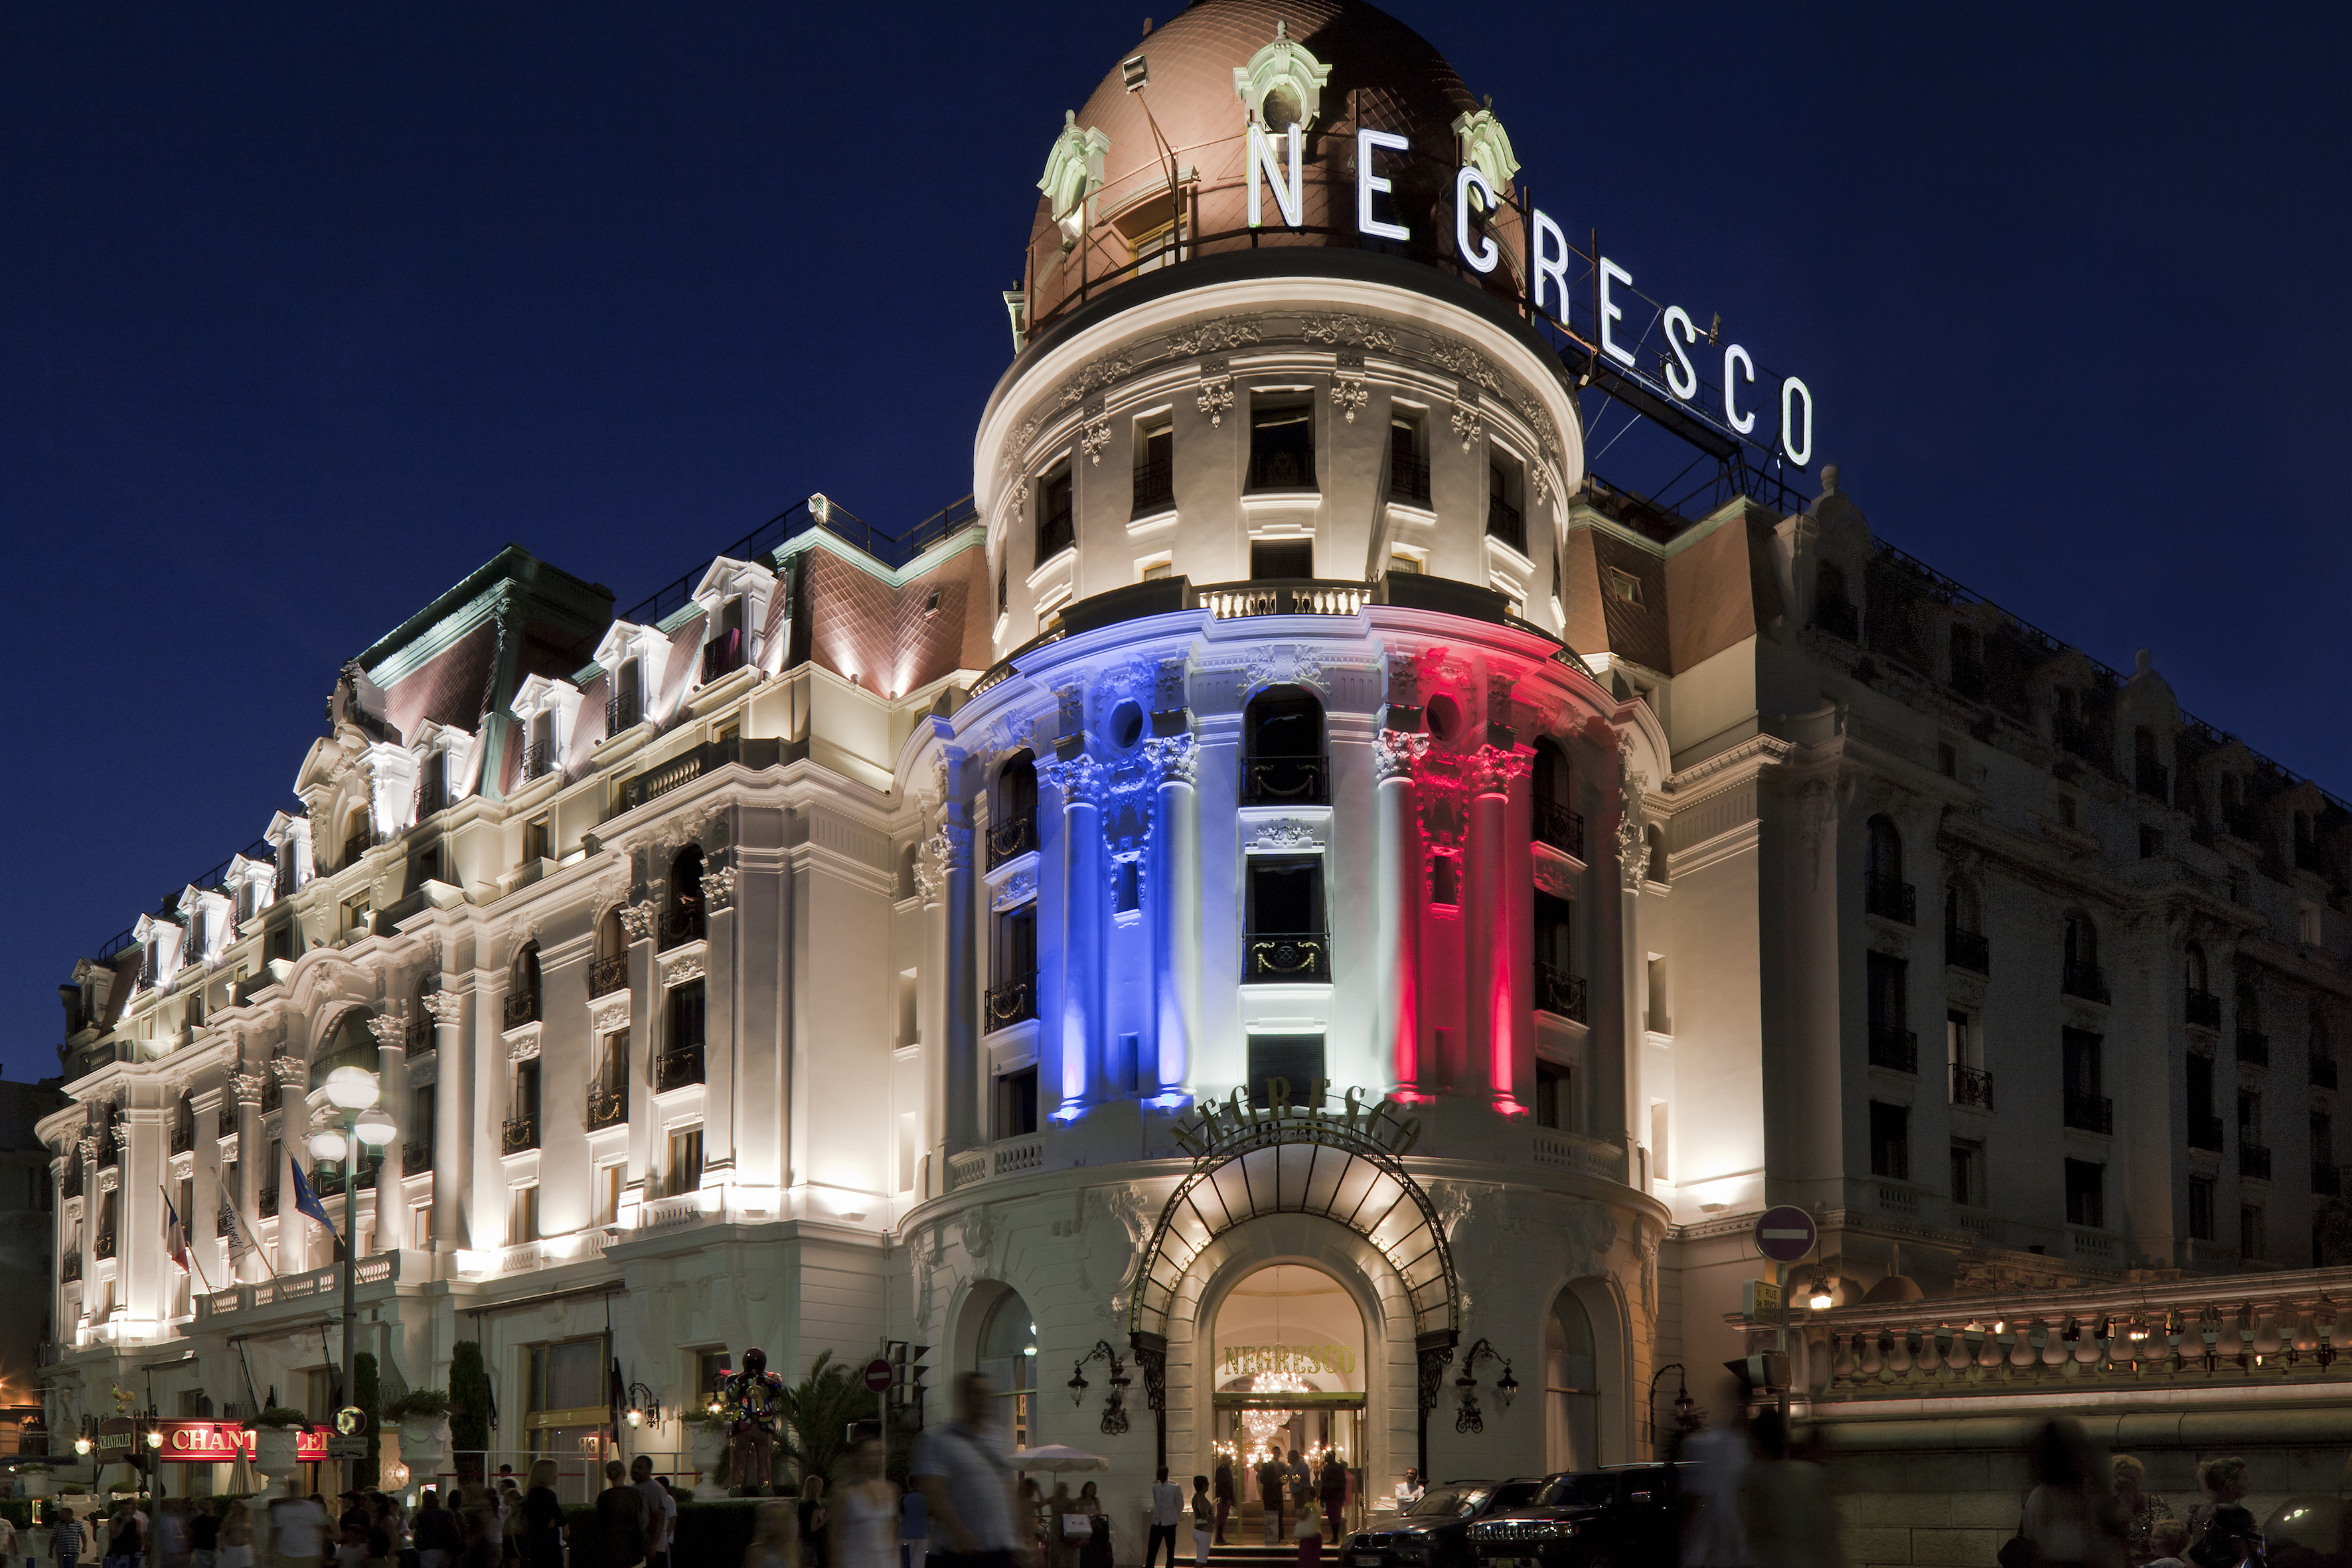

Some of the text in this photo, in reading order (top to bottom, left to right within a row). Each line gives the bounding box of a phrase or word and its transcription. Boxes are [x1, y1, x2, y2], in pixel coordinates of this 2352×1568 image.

[1247, 122, 1812, 466] NEGRESCO
[1169, 1076, 1421, 1156] NEGRESCO
[1764, 1300, 1780, 1311] RIVOLI
[1766, 1289, 1776, 1299] RUE
[1224, 1345, 1356, 1375] NEGRESCO
[172, 1429, 336, 1451] CHANTLER
